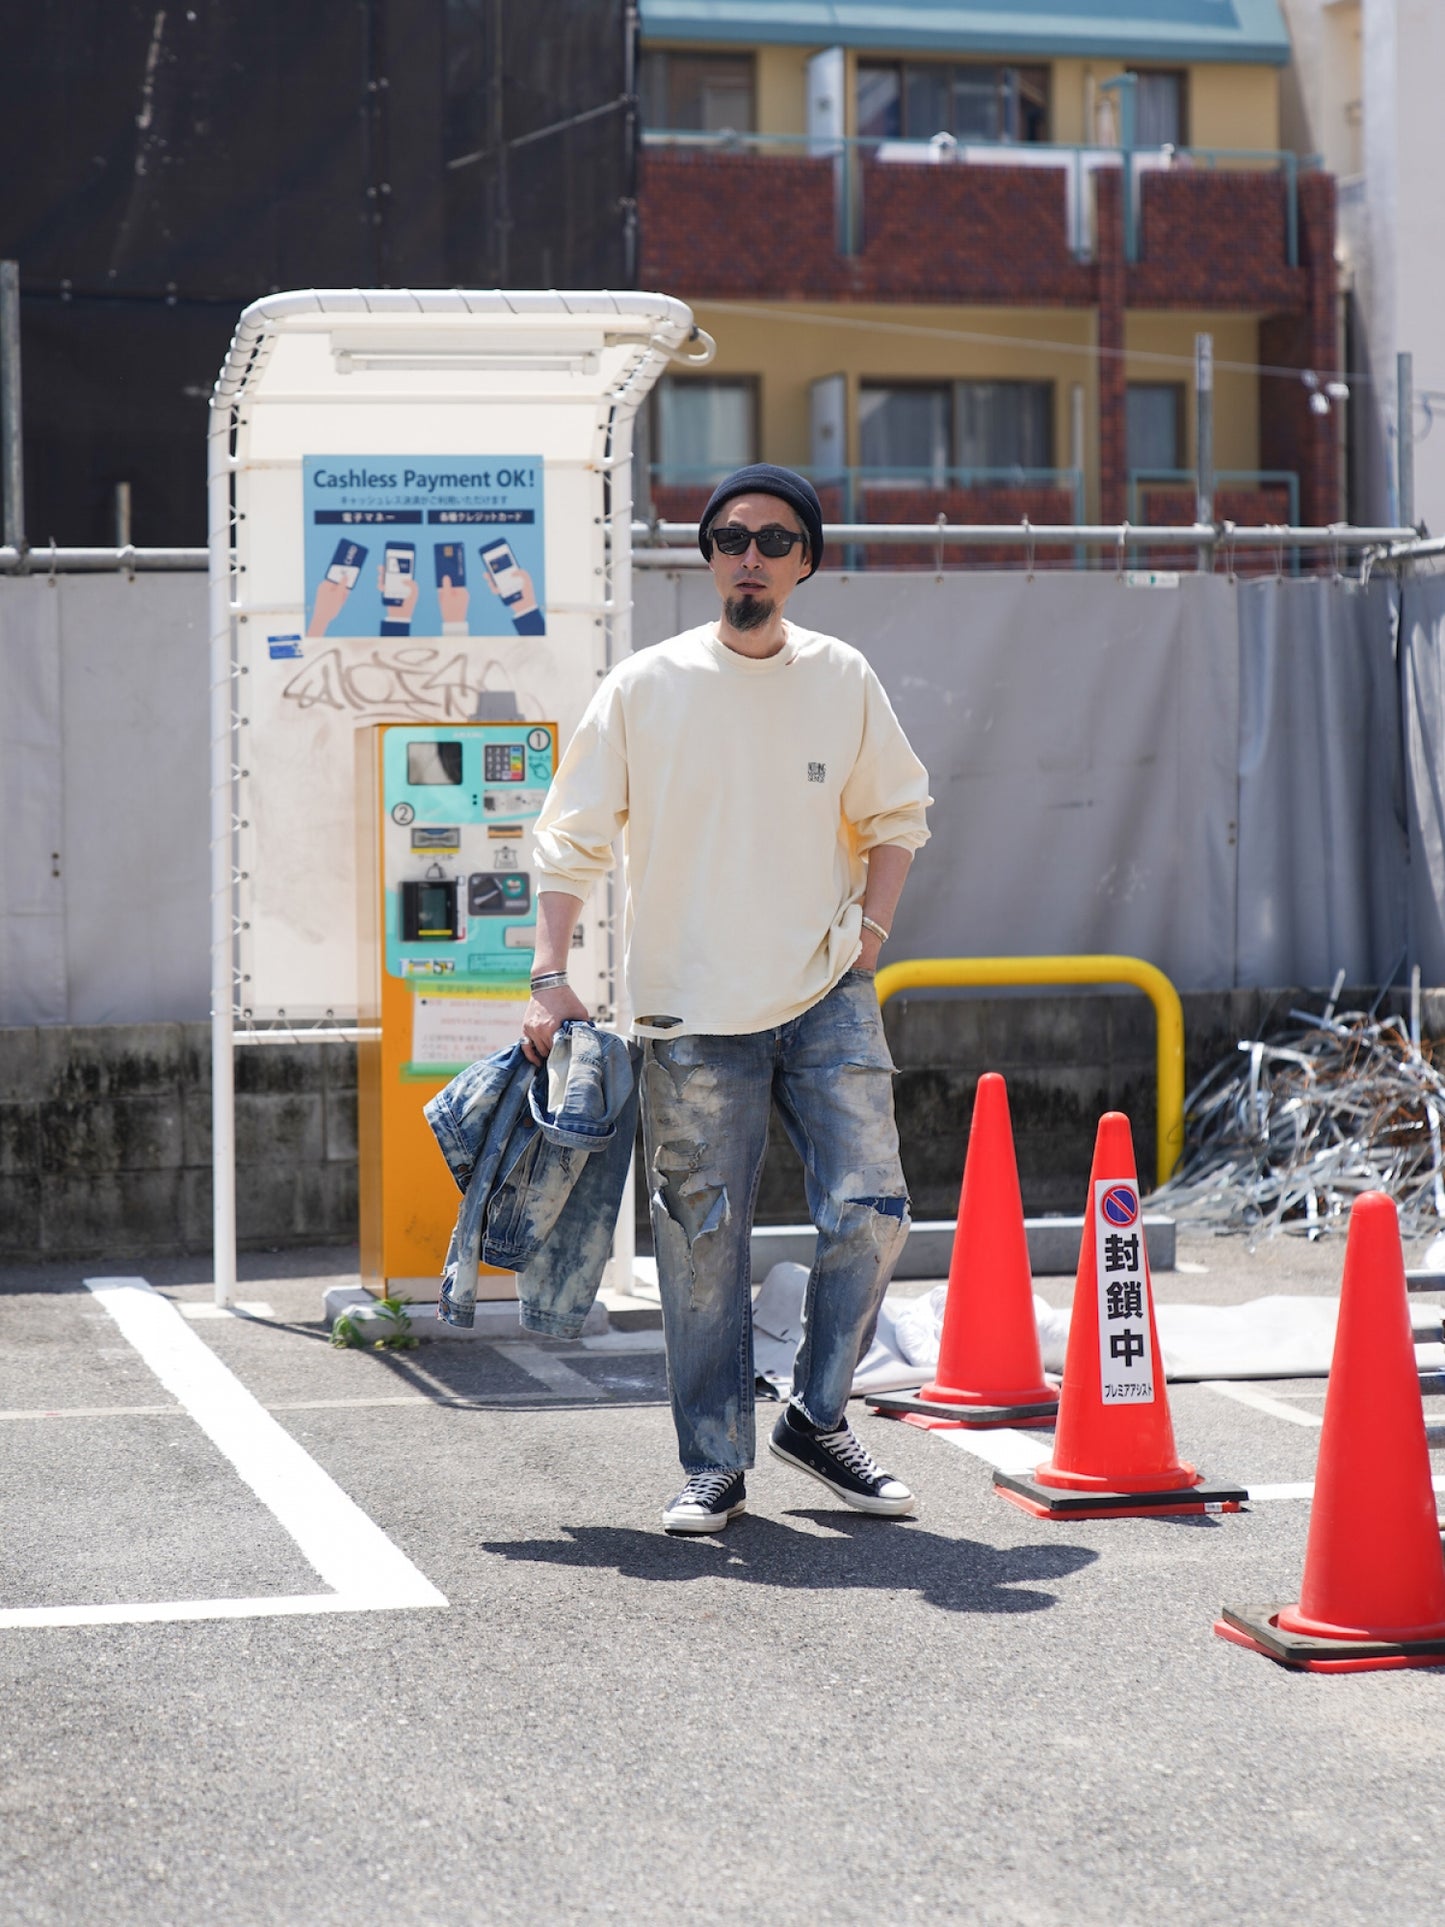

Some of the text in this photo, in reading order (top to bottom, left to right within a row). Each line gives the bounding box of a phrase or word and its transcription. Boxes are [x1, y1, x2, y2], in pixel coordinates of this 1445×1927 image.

[313, 468, 535, 493] Cashless Payment OK!
[1104, 1233, 1145, 1367] 封鎖中
